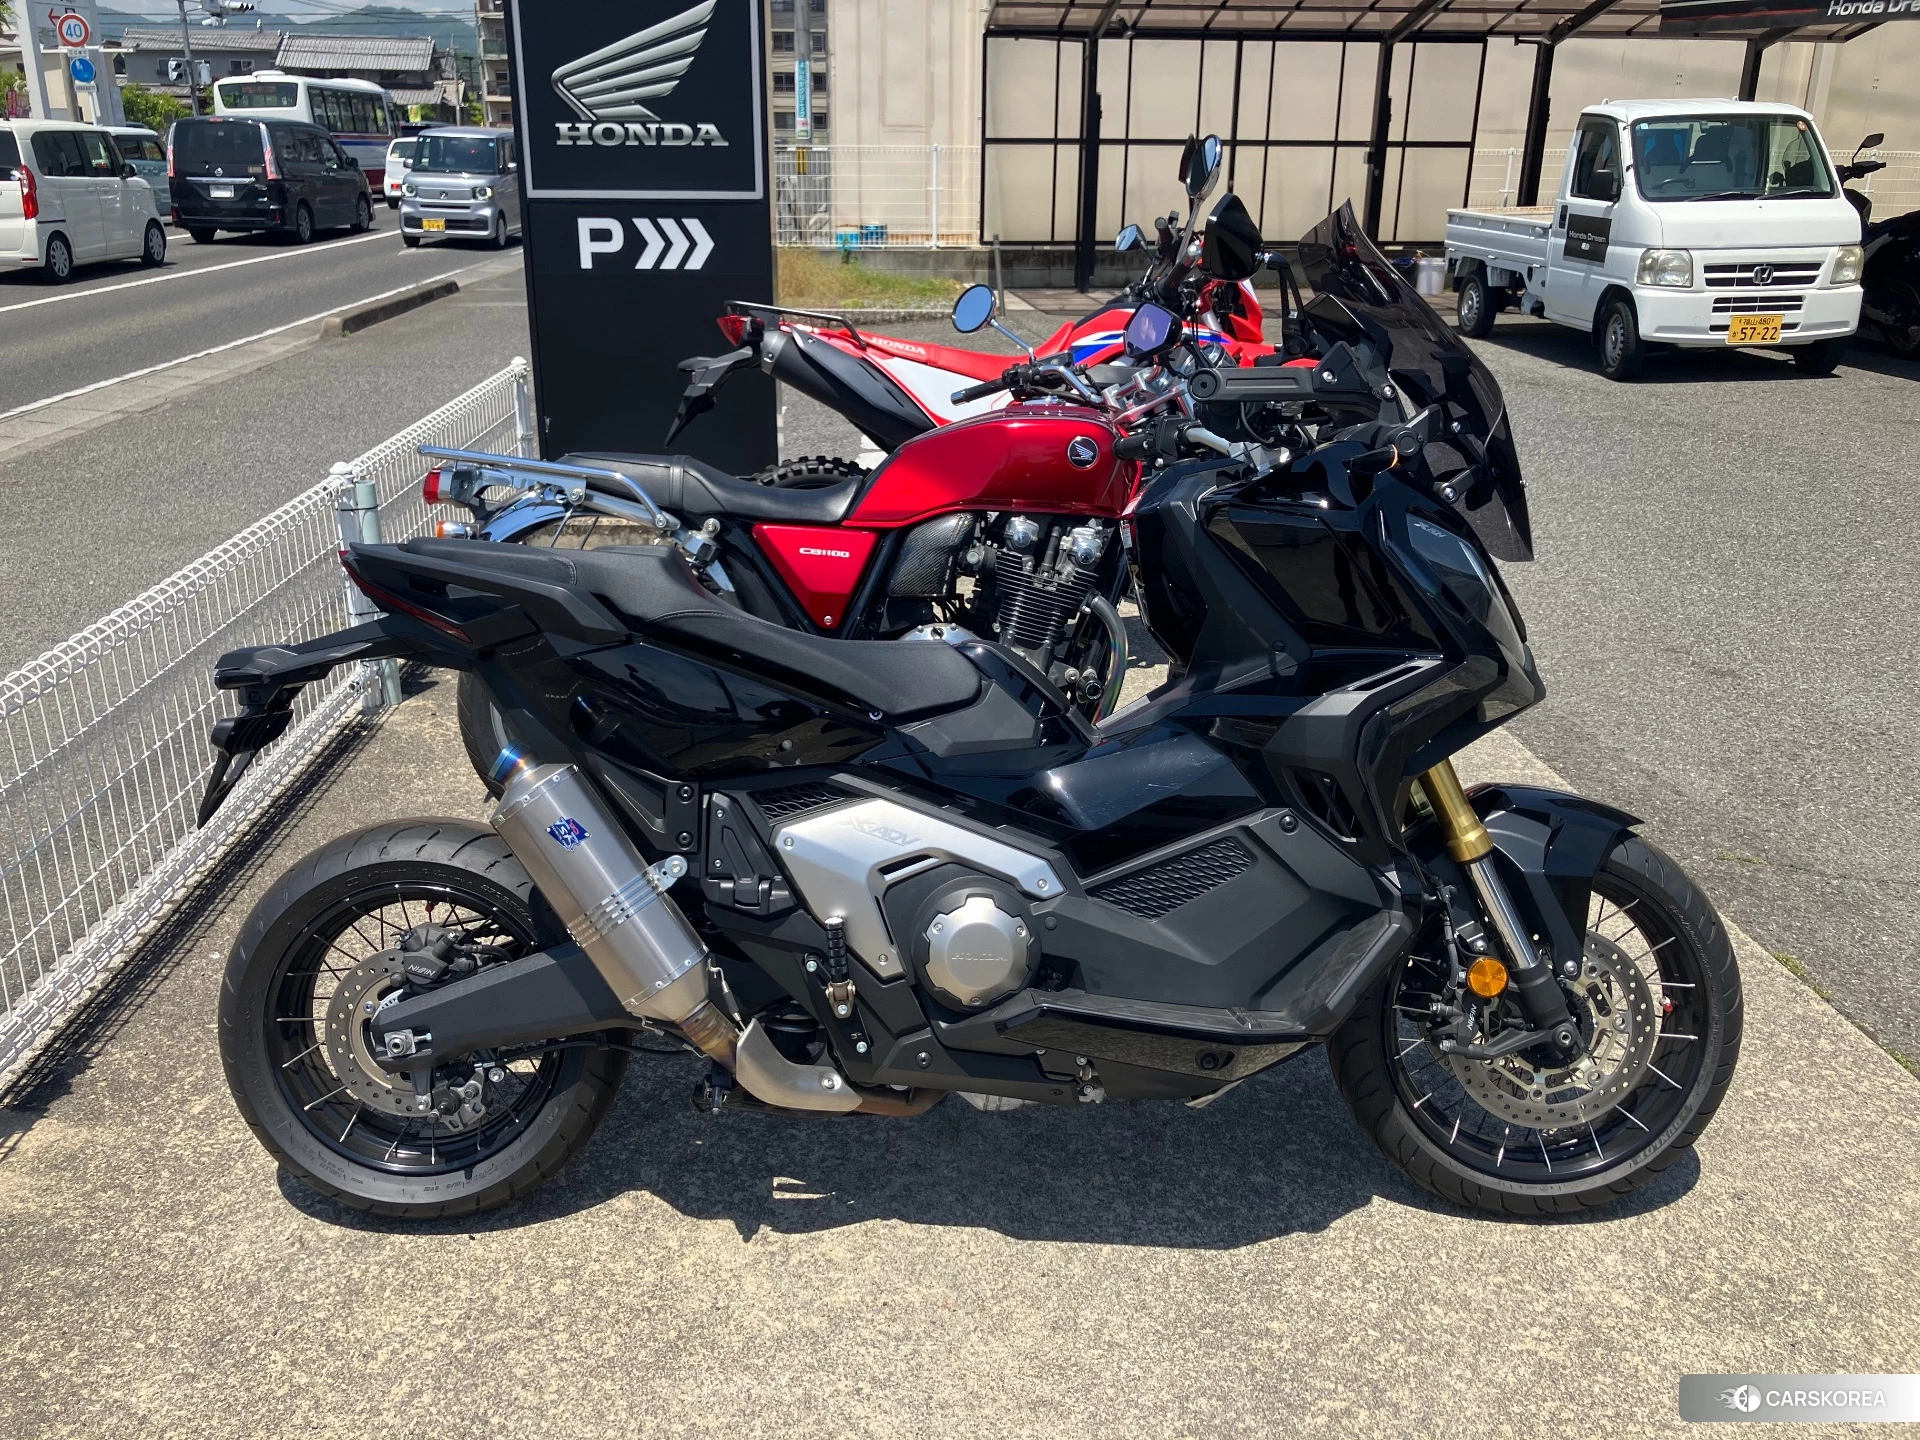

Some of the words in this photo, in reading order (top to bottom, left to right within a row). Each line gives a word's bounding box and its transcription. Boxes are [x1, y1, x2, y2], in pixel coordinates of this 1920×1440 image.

[1827, 0, 1884, 16] Honda
[65, 23, 83, 38] 40
[555, 122, 729, 146] HONDA
[577, 217, 624, 269] P
[1569, 230, 1587, 240] Honda
[1587, 233, 1607, 243] Dream
[1740, 326, 1778, 341] 57-22
[871, 336, 926, 355] HONDA
[799, 547, 850, 558] CB1100
